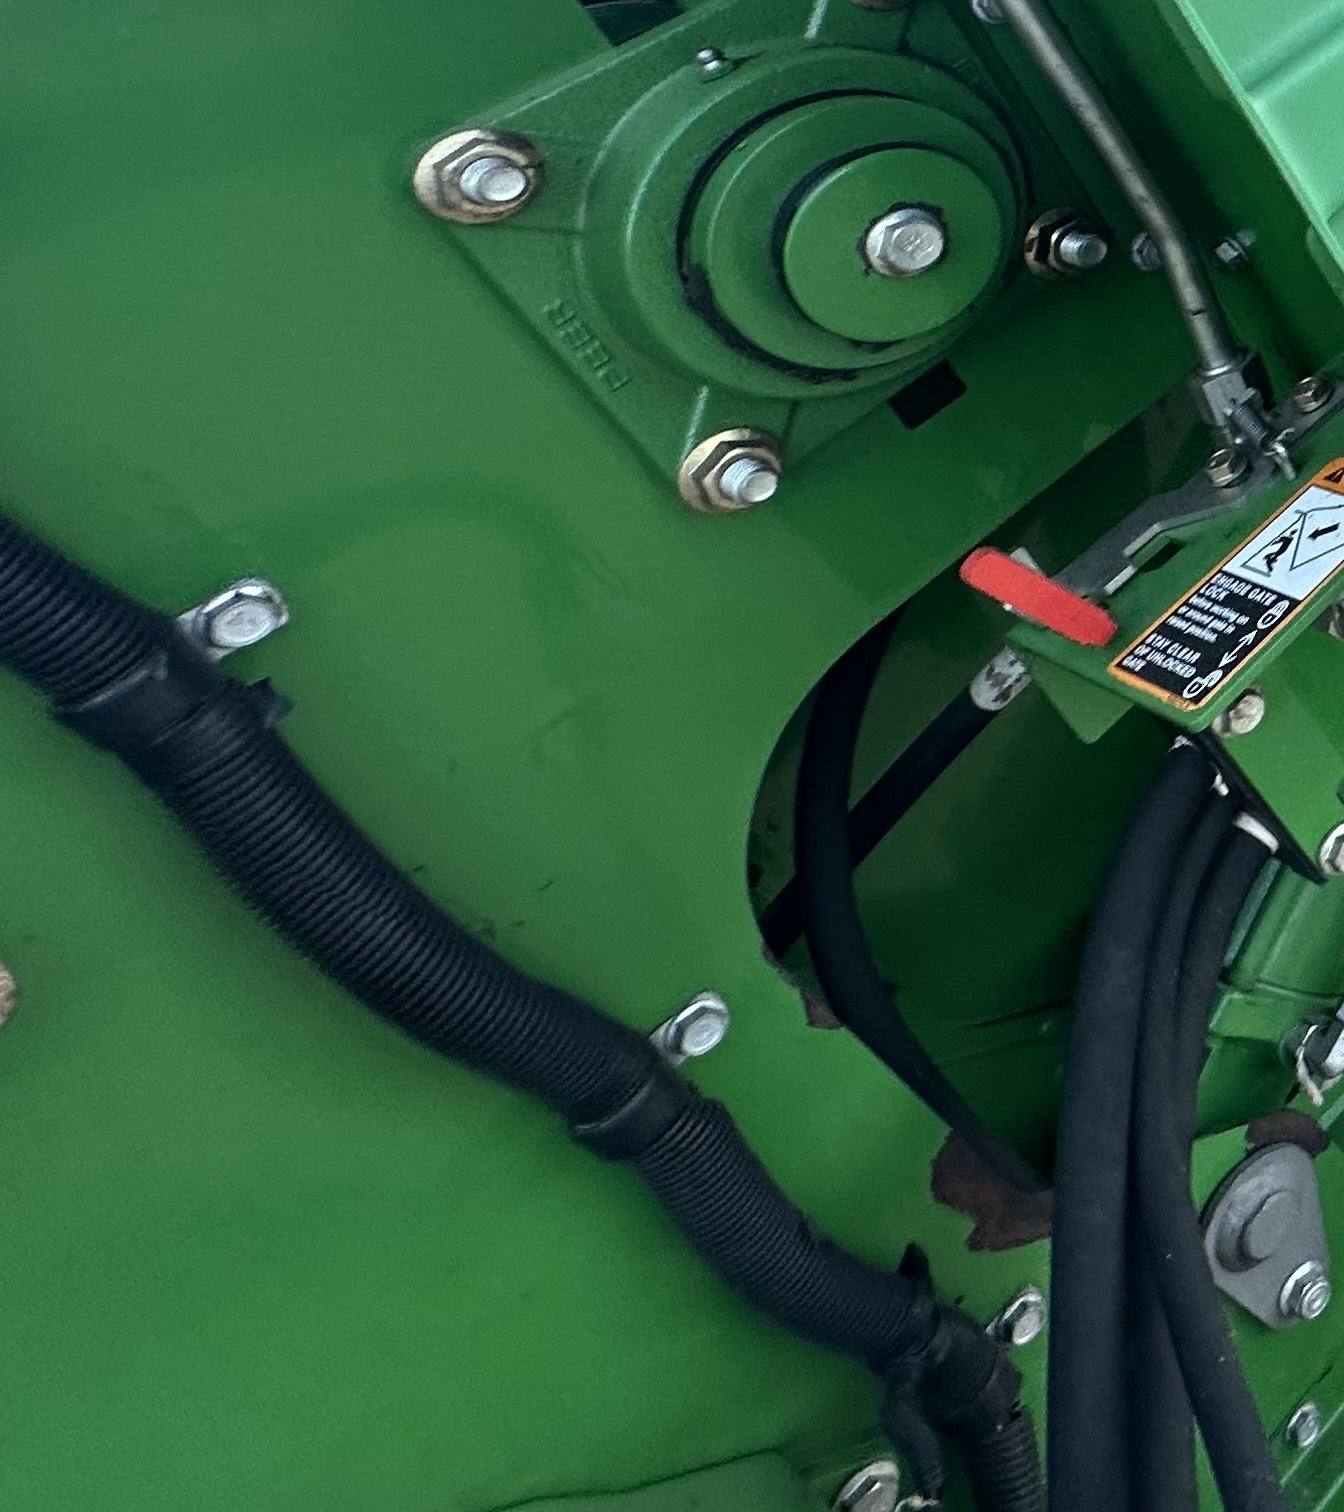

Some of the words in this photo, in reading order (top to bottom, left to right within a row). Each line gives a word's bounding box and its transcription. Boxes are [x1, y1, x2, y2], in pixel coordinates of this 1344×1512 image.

[1199, 583, 1230, 602] LOCK
[1249, 587, 1279, 606] GATE
[1144, 632, 1173, 650] STAY
[1166, 641, 1201, 664] CLEAR
[1146, 649, 1197, 678] UNLOCKED
